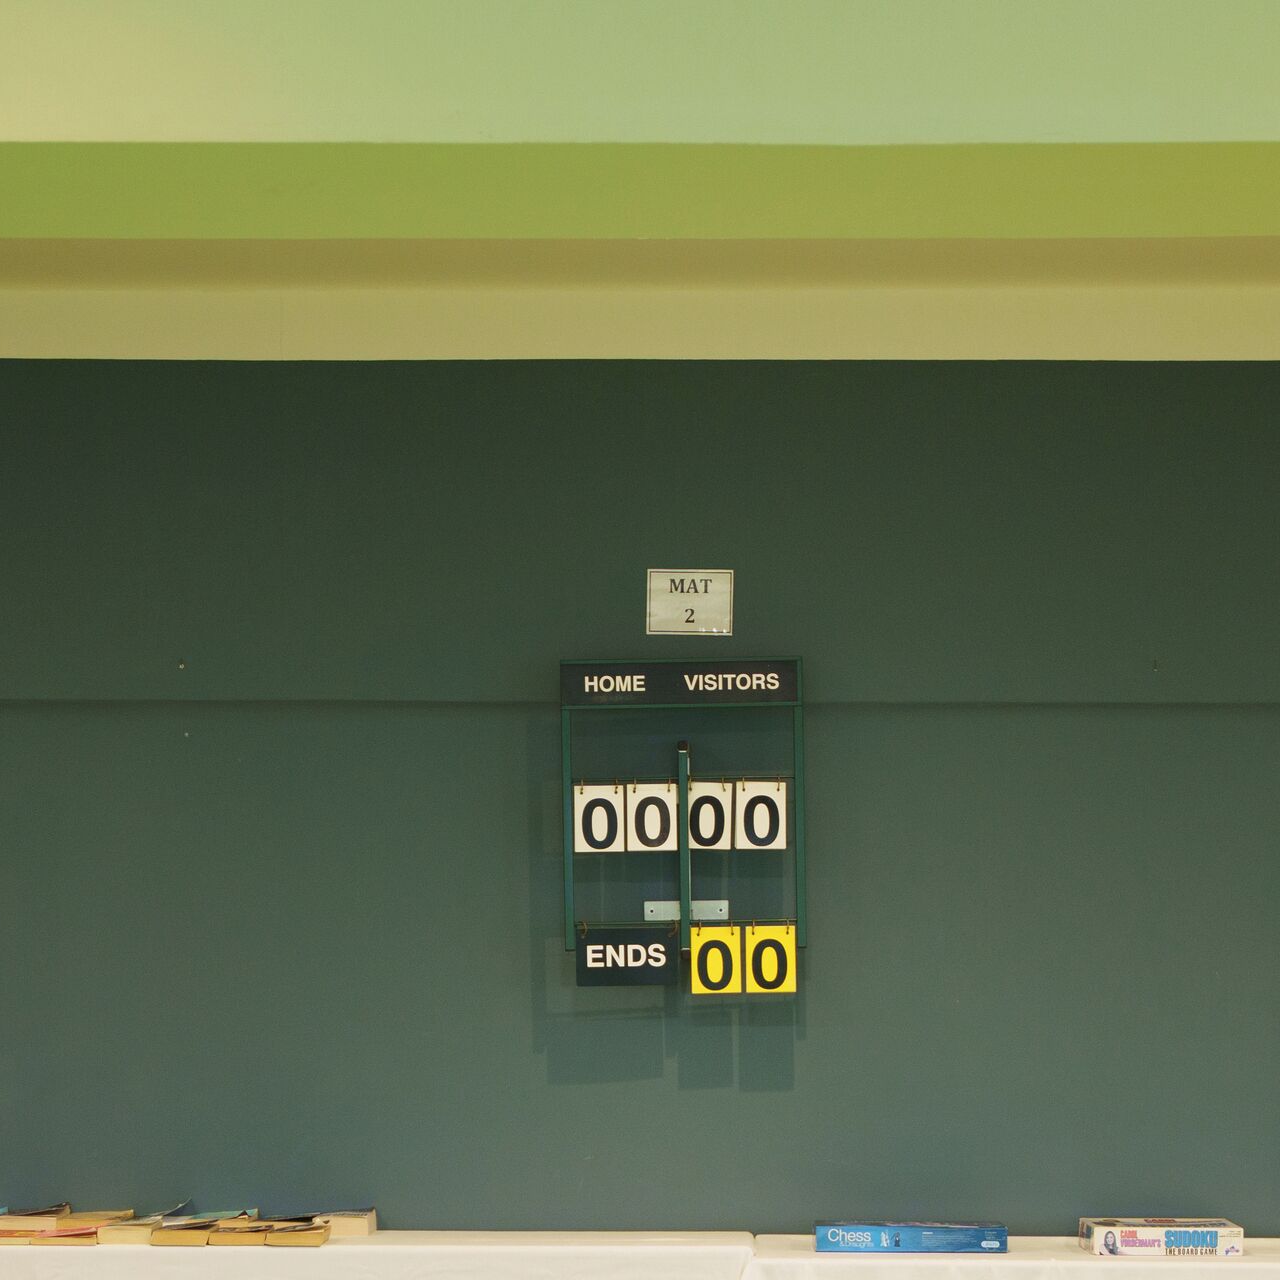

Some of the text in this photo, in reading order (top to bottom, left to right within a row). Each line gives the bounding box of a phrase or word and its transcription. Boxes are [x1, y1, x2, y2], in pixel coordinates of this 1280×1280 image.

[669, 578, 712, 594] MAT
[684, 608, 695, 624] 2
[584, 673, 780, 692] HOME VISITORS
[581, 796, 671, 850] 00
[586, 938, 788, 990] ENDS 00
[827, 1228, 871, 1242] Chess
[1165, 1230, 1218, 1248] SUDOKU
